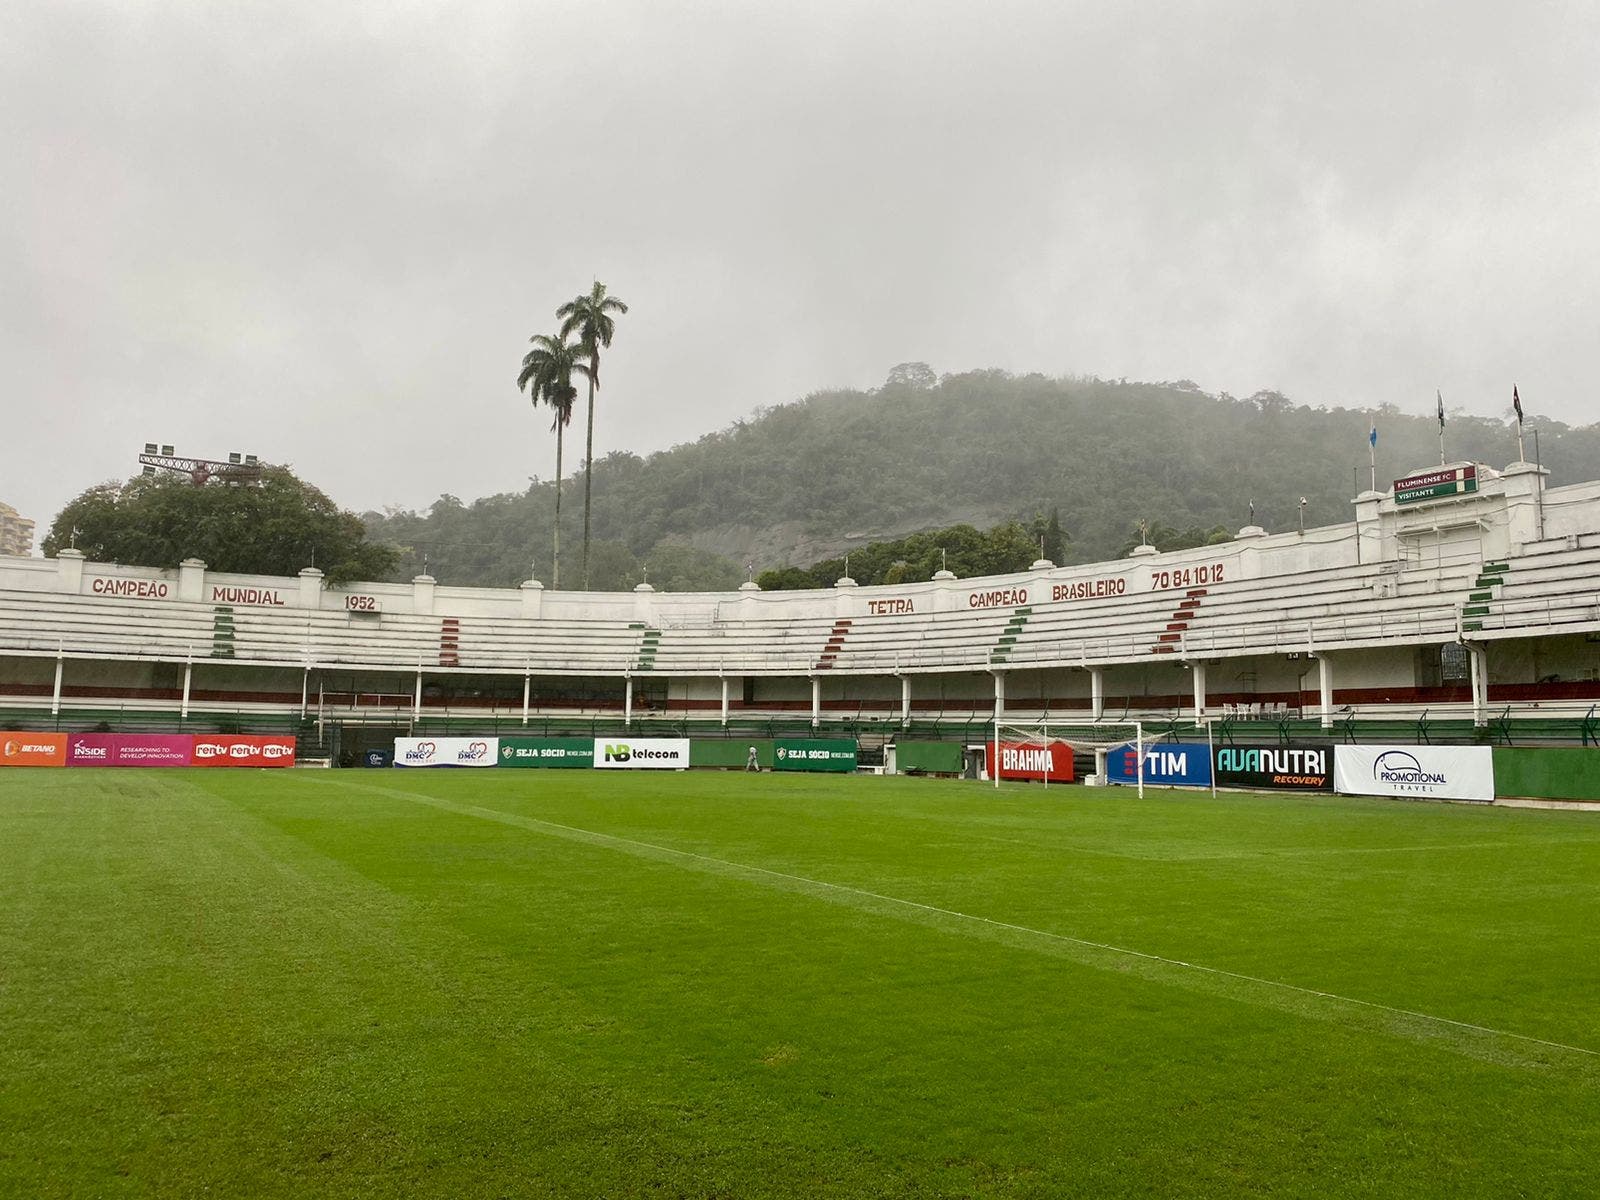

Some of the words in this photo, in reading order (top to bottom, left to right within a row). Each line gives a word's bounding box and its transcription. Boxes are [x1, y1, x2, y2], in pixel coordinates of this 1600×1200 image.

[1397, 475, 1440, 488] FLUMINENSE
[1398, 488, 1434, 500] VISITANTE
[93, 578, 168, 598] CAMPEÃO
[213, 586, 285, 606] MUNDIAL
[345, 595, 375, 610] 1952
[868, 598, 914, 615] TETRA
[969, 586, 1028, 608] CAMPEÃO
[1052, 577, 1126, 601] BRASILEIRO
[1152, 571, 1169, 590] 70
[1173, 570, 1190, 587] 84
[1194, 566, 1208, 583] 10
[1211, 563, 1223, 582] 12
[21, 744, 56, 753] BETANO
[74, 747, 107, 756] INSIDE
[516, 748, 538, 757] SEJA
[605, 744, 630, 762] NB
[632, 748, 679, 760] telecom
[788, 750, 807, 759] SEJA
[405, 752, 425, 760] DMC
[458, 752, 478, 760] DMC
[1002, 749, 1054, 772] BRAHMA
[1217, 748, 1326, 775] AVANUTRI
[1148, 752, 1187, 776] TIM
[1273, 775, 1325, 786] RECOVERY
[1380, 771, 1446, 784] PROMOTIONAL
[1393, 784, 1434, 792] TRAVEL
